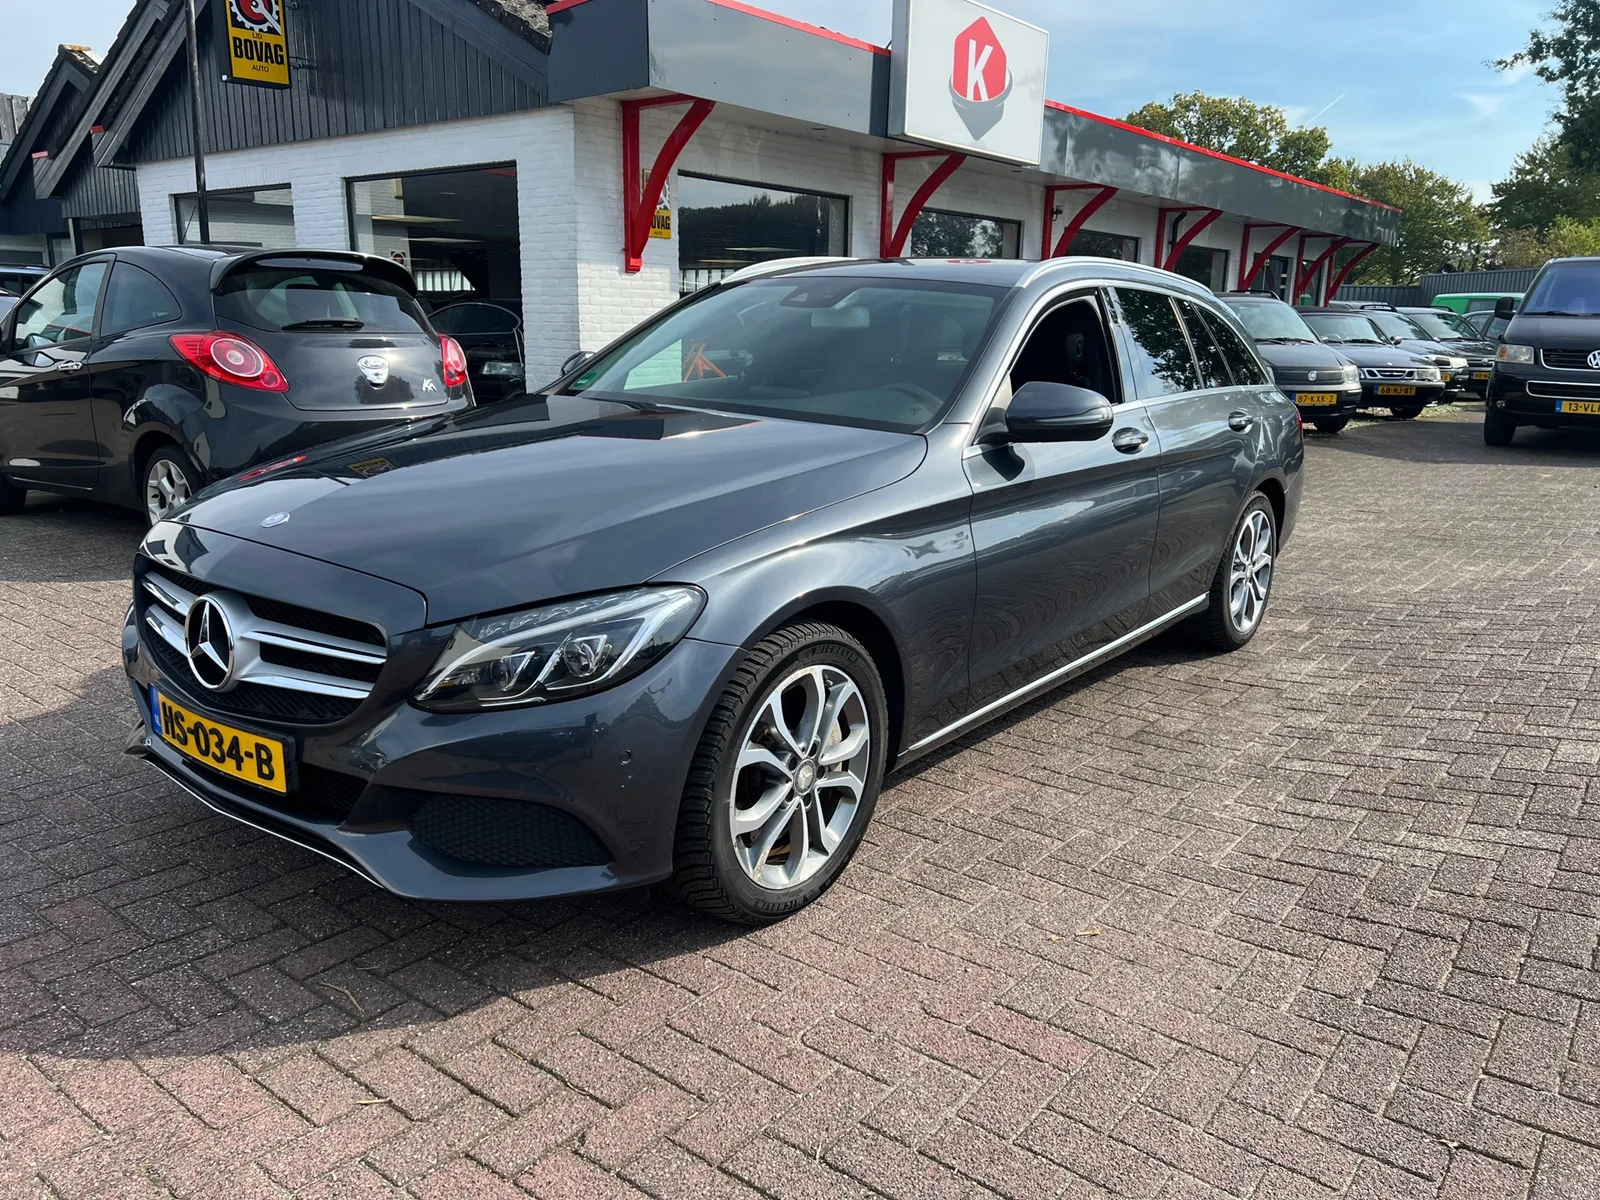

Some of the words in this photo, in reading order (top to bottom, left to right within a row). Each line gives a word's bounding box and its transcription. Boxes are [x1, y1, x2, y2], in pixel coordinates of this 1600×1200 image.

[232, 36, 285, 66] BOVAG
[252, 64, 269, 73] AUTO
[966, 38, 994, 102] K
[651, 214, 671, 230] OVAG
[1297, 394, 1333, 403] 87-KXK-2
[161, 701, 275, 781] HS-034-B
